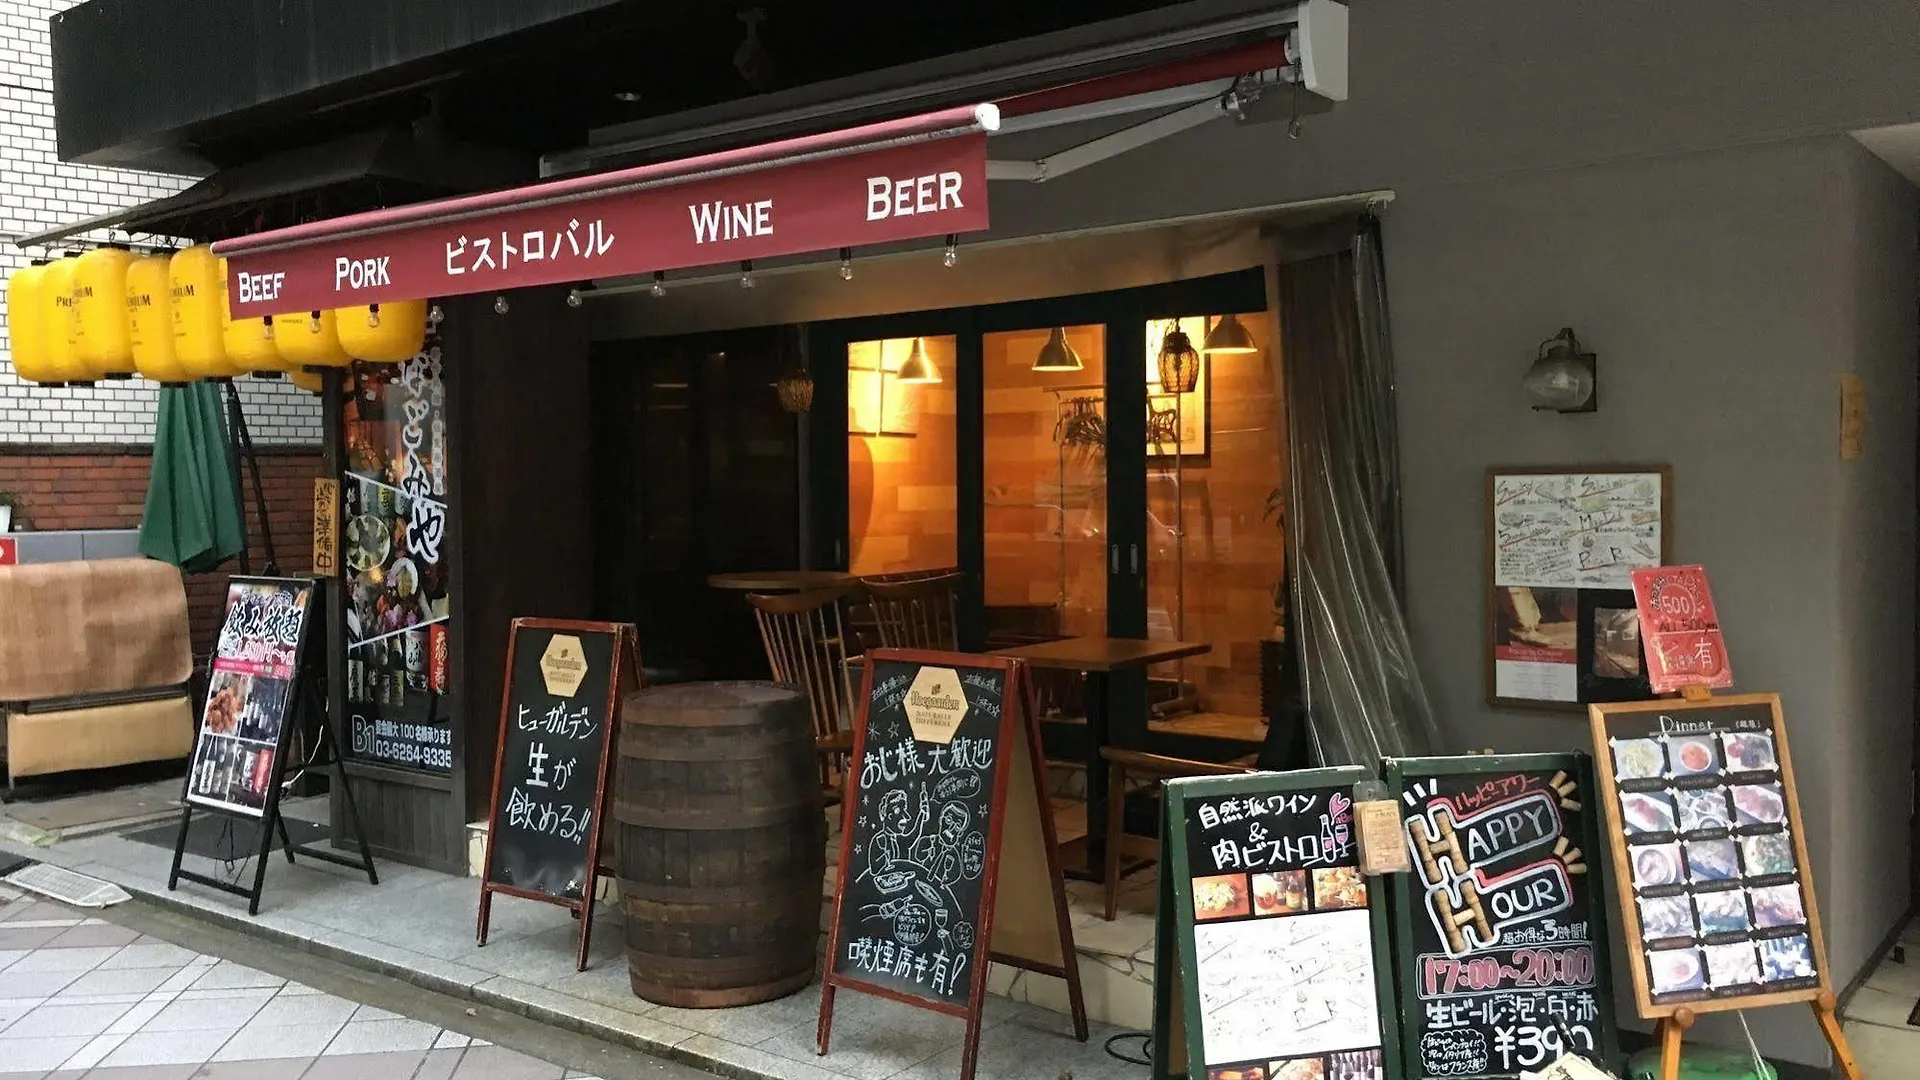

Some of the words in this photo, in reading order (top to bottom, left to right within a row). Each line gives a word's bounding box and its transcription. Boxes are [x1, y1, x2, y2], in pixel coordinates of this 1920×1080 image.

[865, 170, 965, 222] BEER
[688, 198, 774, 244] WINE
[446, 218, 615, 276] ビストロバル
[238, 271, 285, 303] BEEF
[335, 255, 391, 291] PORK
[222, 600, 303, 644] 飲み放題
[1662, 595, 1690, 614] 500
[1695, 636, 1713, 669] 有
[351, 714, 376, 754] B1
[518, 700, 598, 740] ヒューガルデン
[1659, 714, 1714, 734] Dinner
[375, 738, 452, 772] 03-6264-9335
[525, 741, 577, 792] 生が
[860, 736, 926, 789] おじ様
[927, 737, 993, 777] 大歓迎
[1198, 793, 1317, 830] 自然派ワイン
[1211, 834, 1319, 870] 肉ビストロ
[1248, 821, 1269, 844] &
[1408, 804, 1545, 885] HAPPY
[1434, 877, 1557, 955] HOUR
[848, 936, 967, 996] 喫煙席も有!
